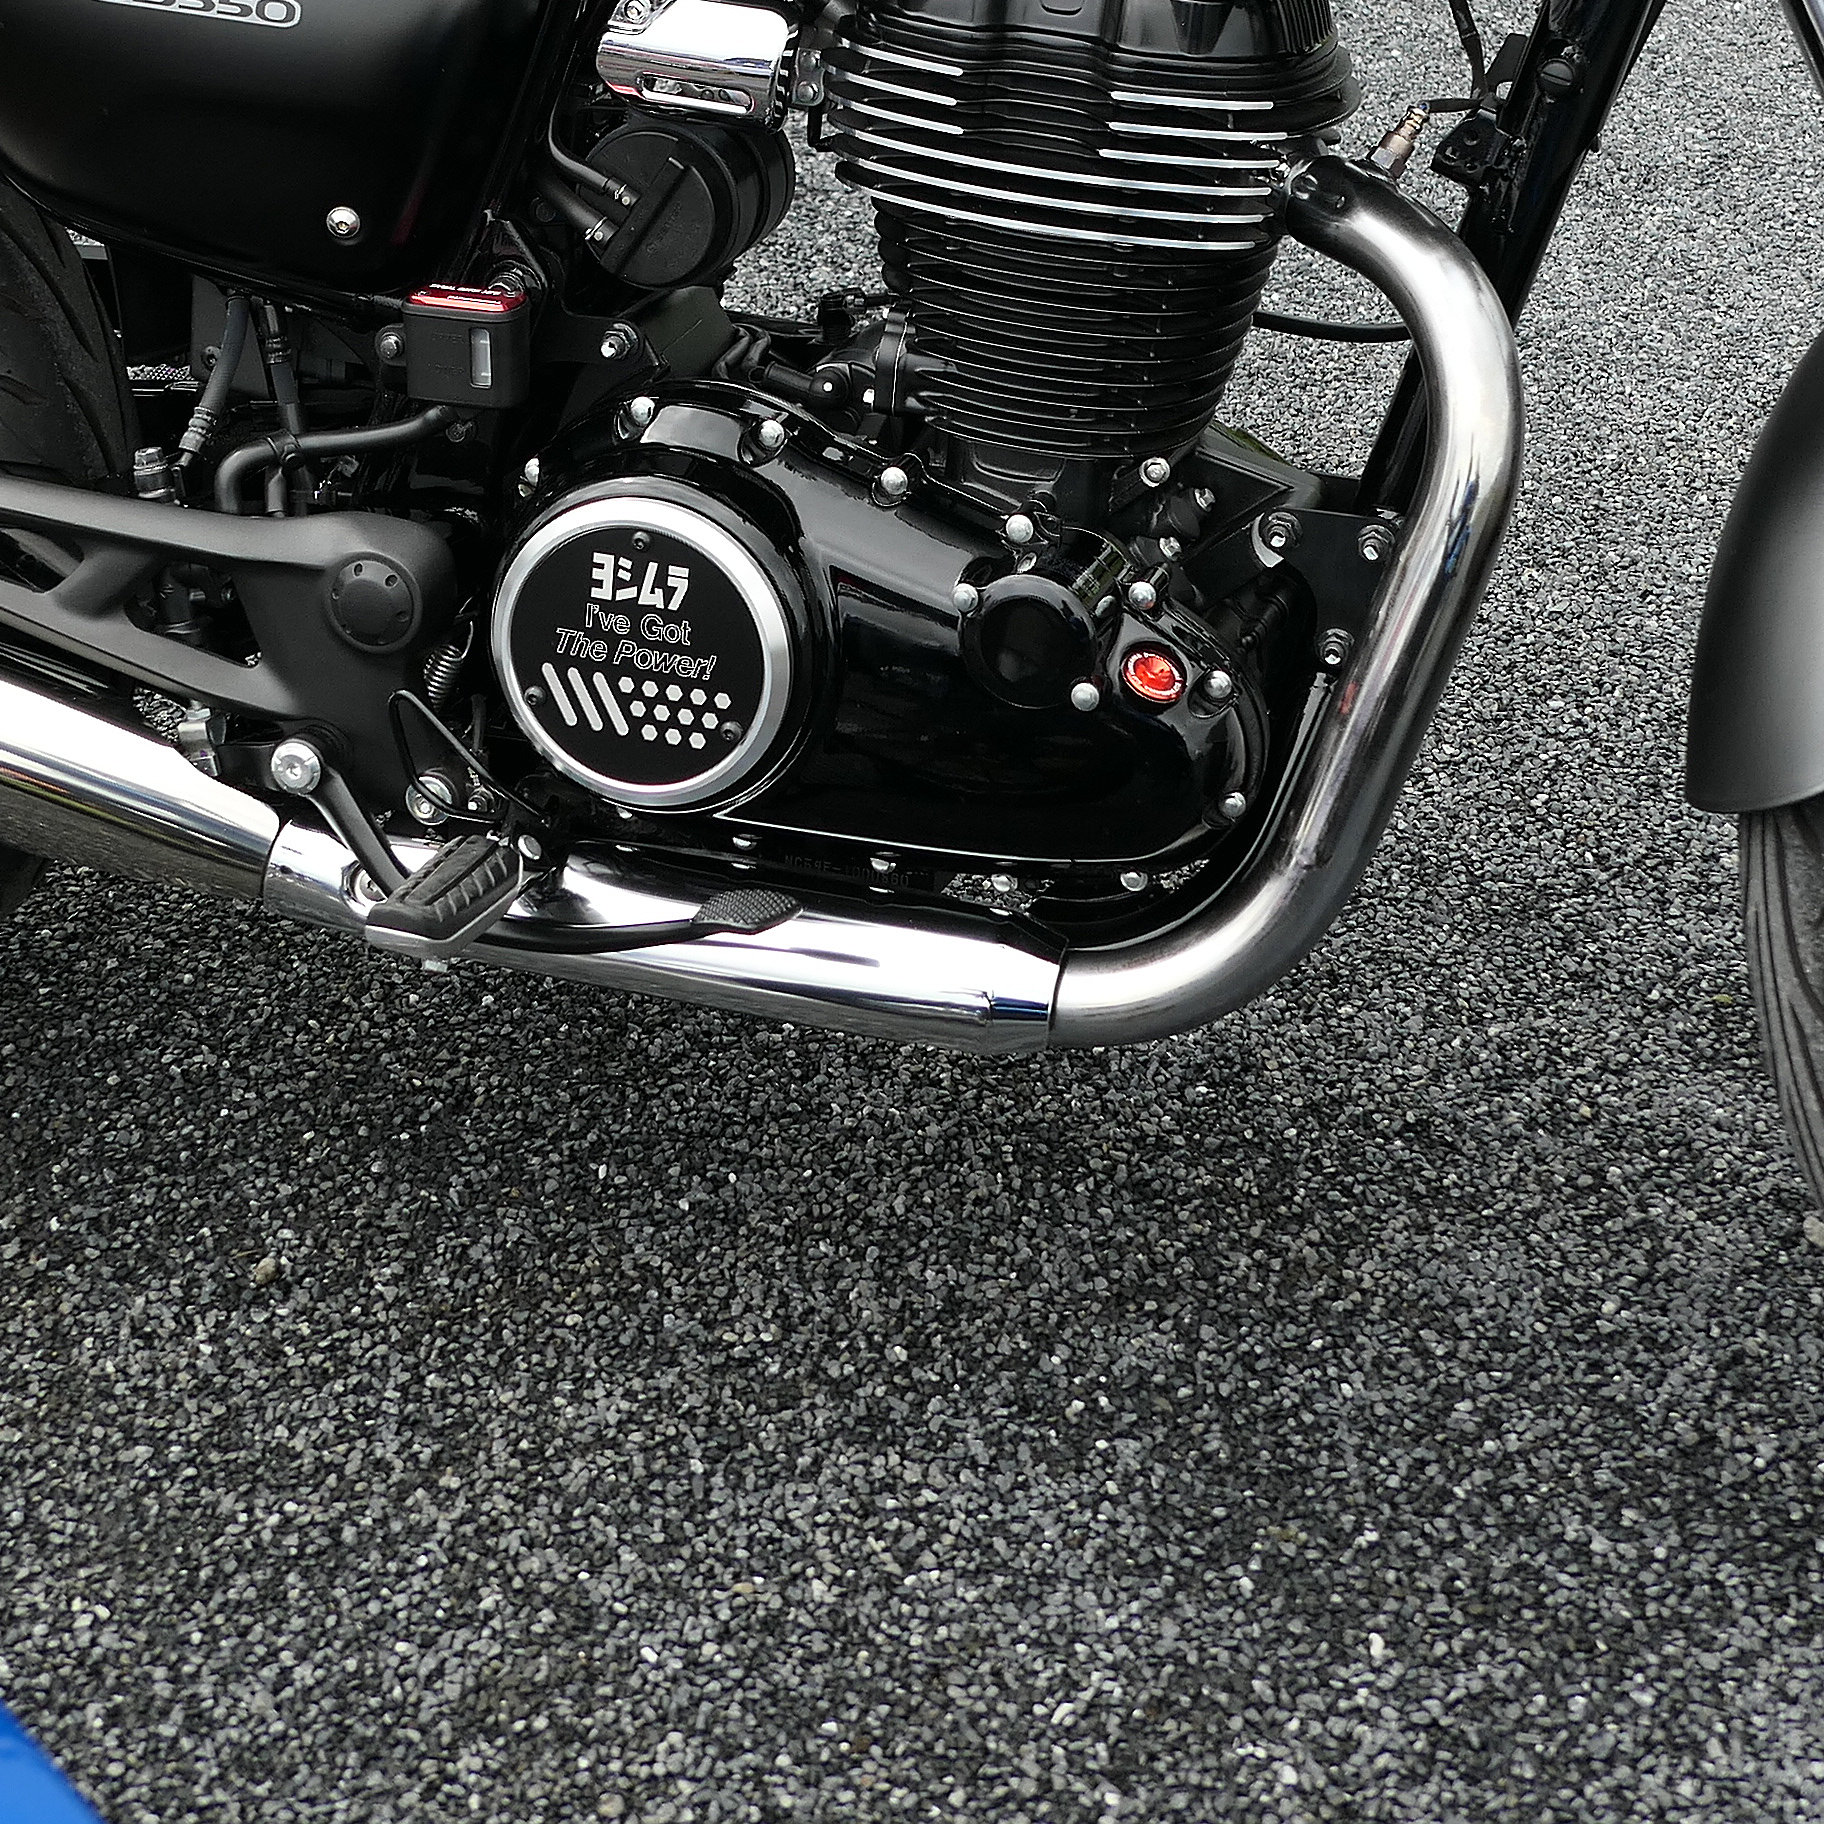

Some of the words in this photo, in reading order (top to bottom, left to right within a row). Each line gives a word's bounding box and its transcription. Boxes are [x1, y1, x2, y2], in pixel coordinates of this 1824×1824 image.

[584, 603, 631, 636] I've
[640, 613, 692, 647] Got
[555, 626, 609, 662] The
[612, 639, 718, 682] Power!
